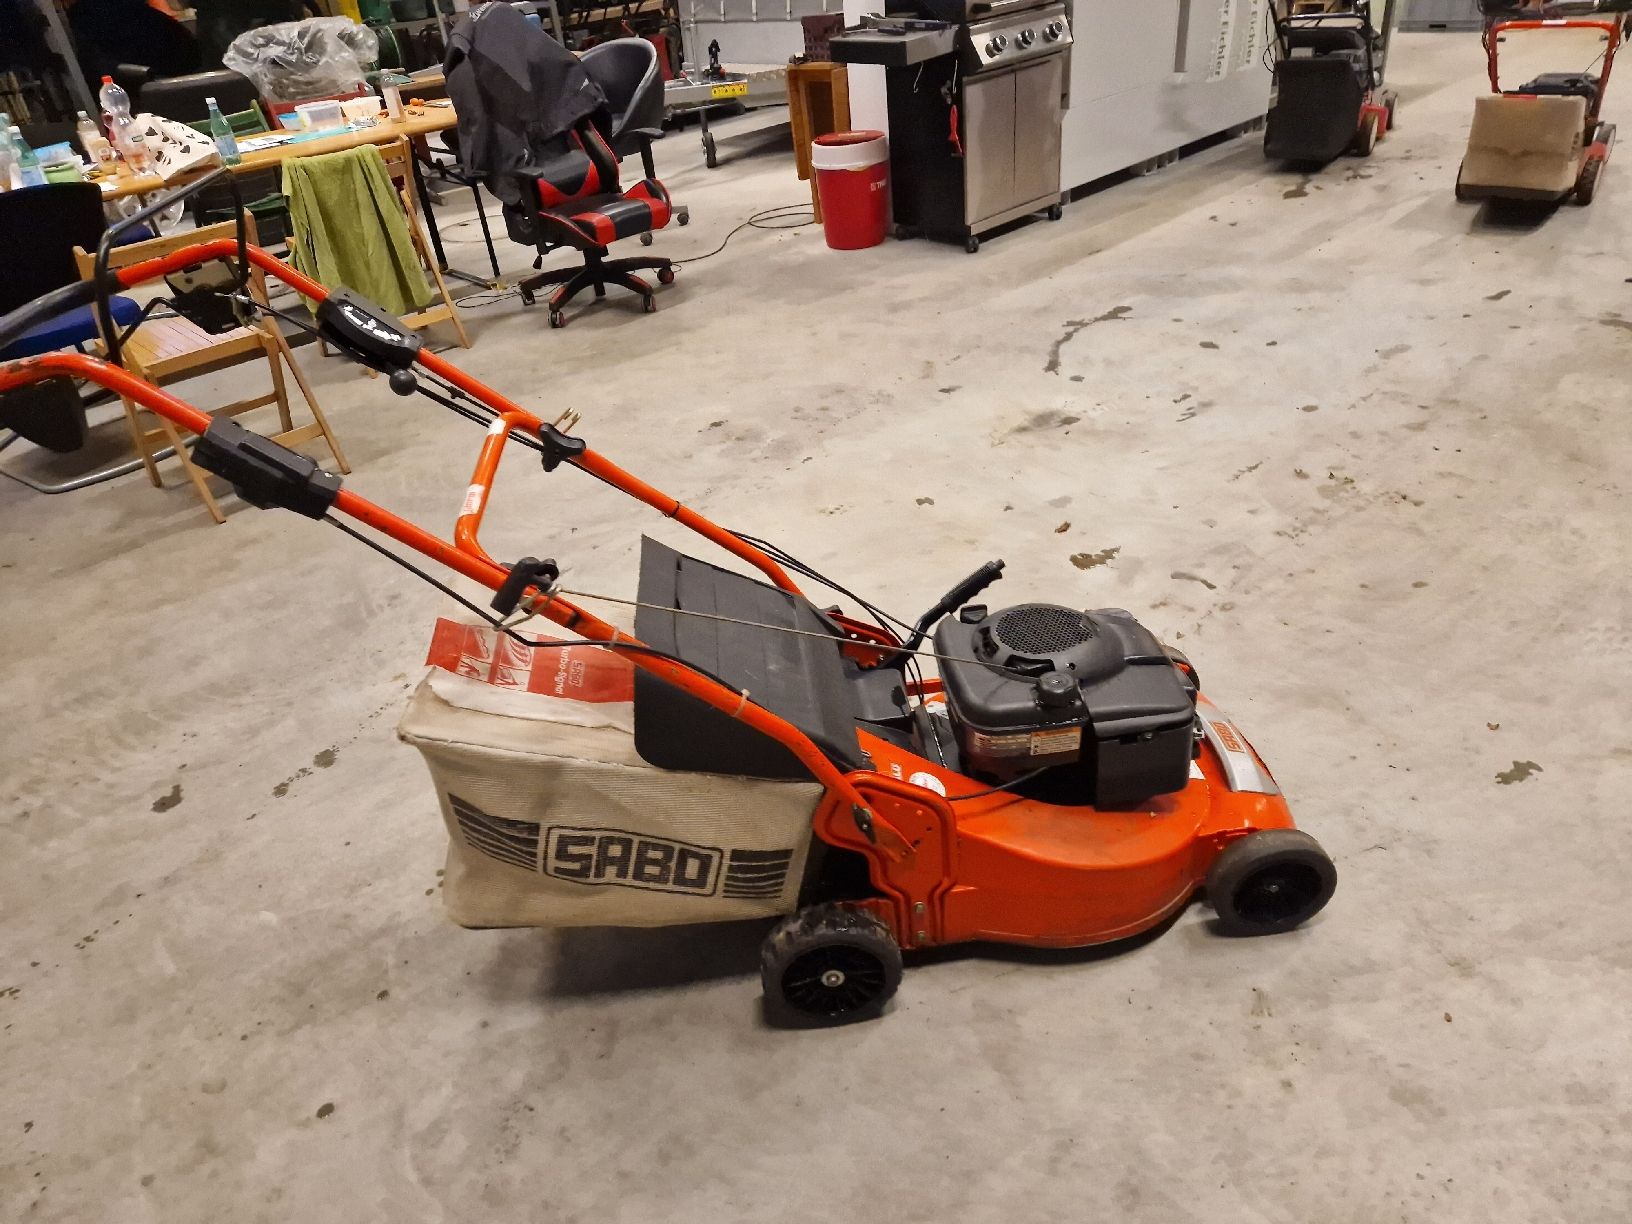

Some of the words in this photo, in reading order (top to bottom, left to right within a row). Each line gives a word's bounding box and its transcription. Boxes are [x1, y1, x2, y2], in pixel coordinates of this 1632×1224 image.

[1215, 21, 1230, 76] Eichler
[1246, 11, 1258, 64] Eichler
[553, 834, 714, 890] SABO
